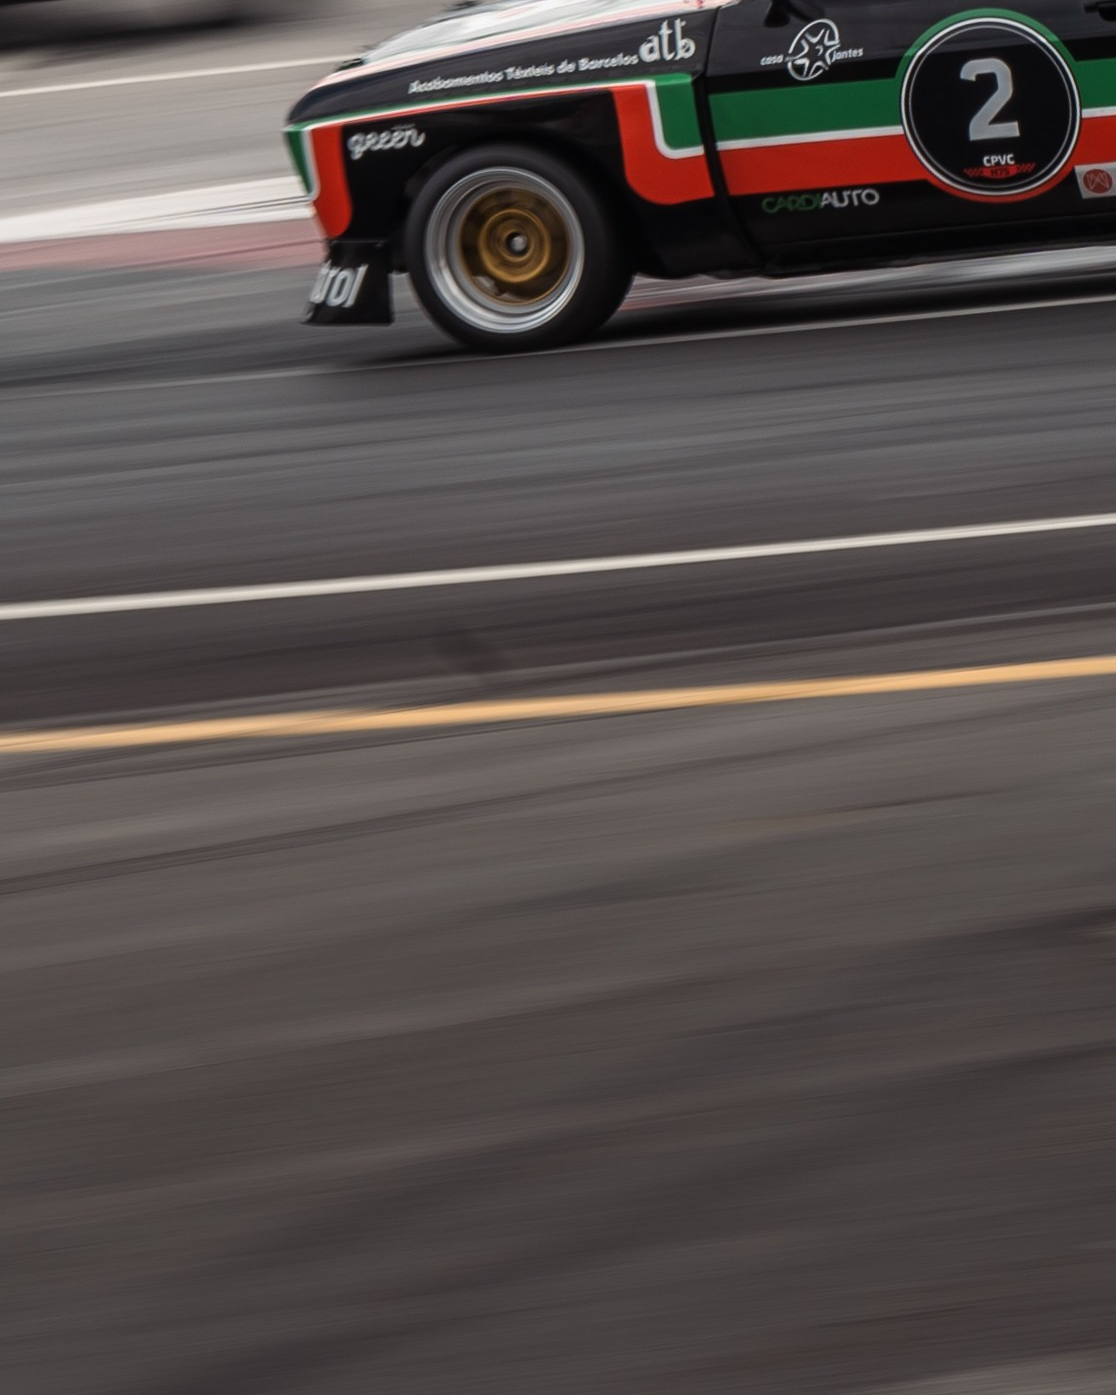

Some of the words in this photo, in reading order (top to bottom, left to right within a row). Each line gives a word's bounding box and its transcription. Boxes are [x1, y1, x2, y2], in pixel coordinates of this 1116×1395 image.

[638, 18, 696, 63] atb
[960, 57, 1020, 141] 2
[983, 153, 1015, 167] CPVC
